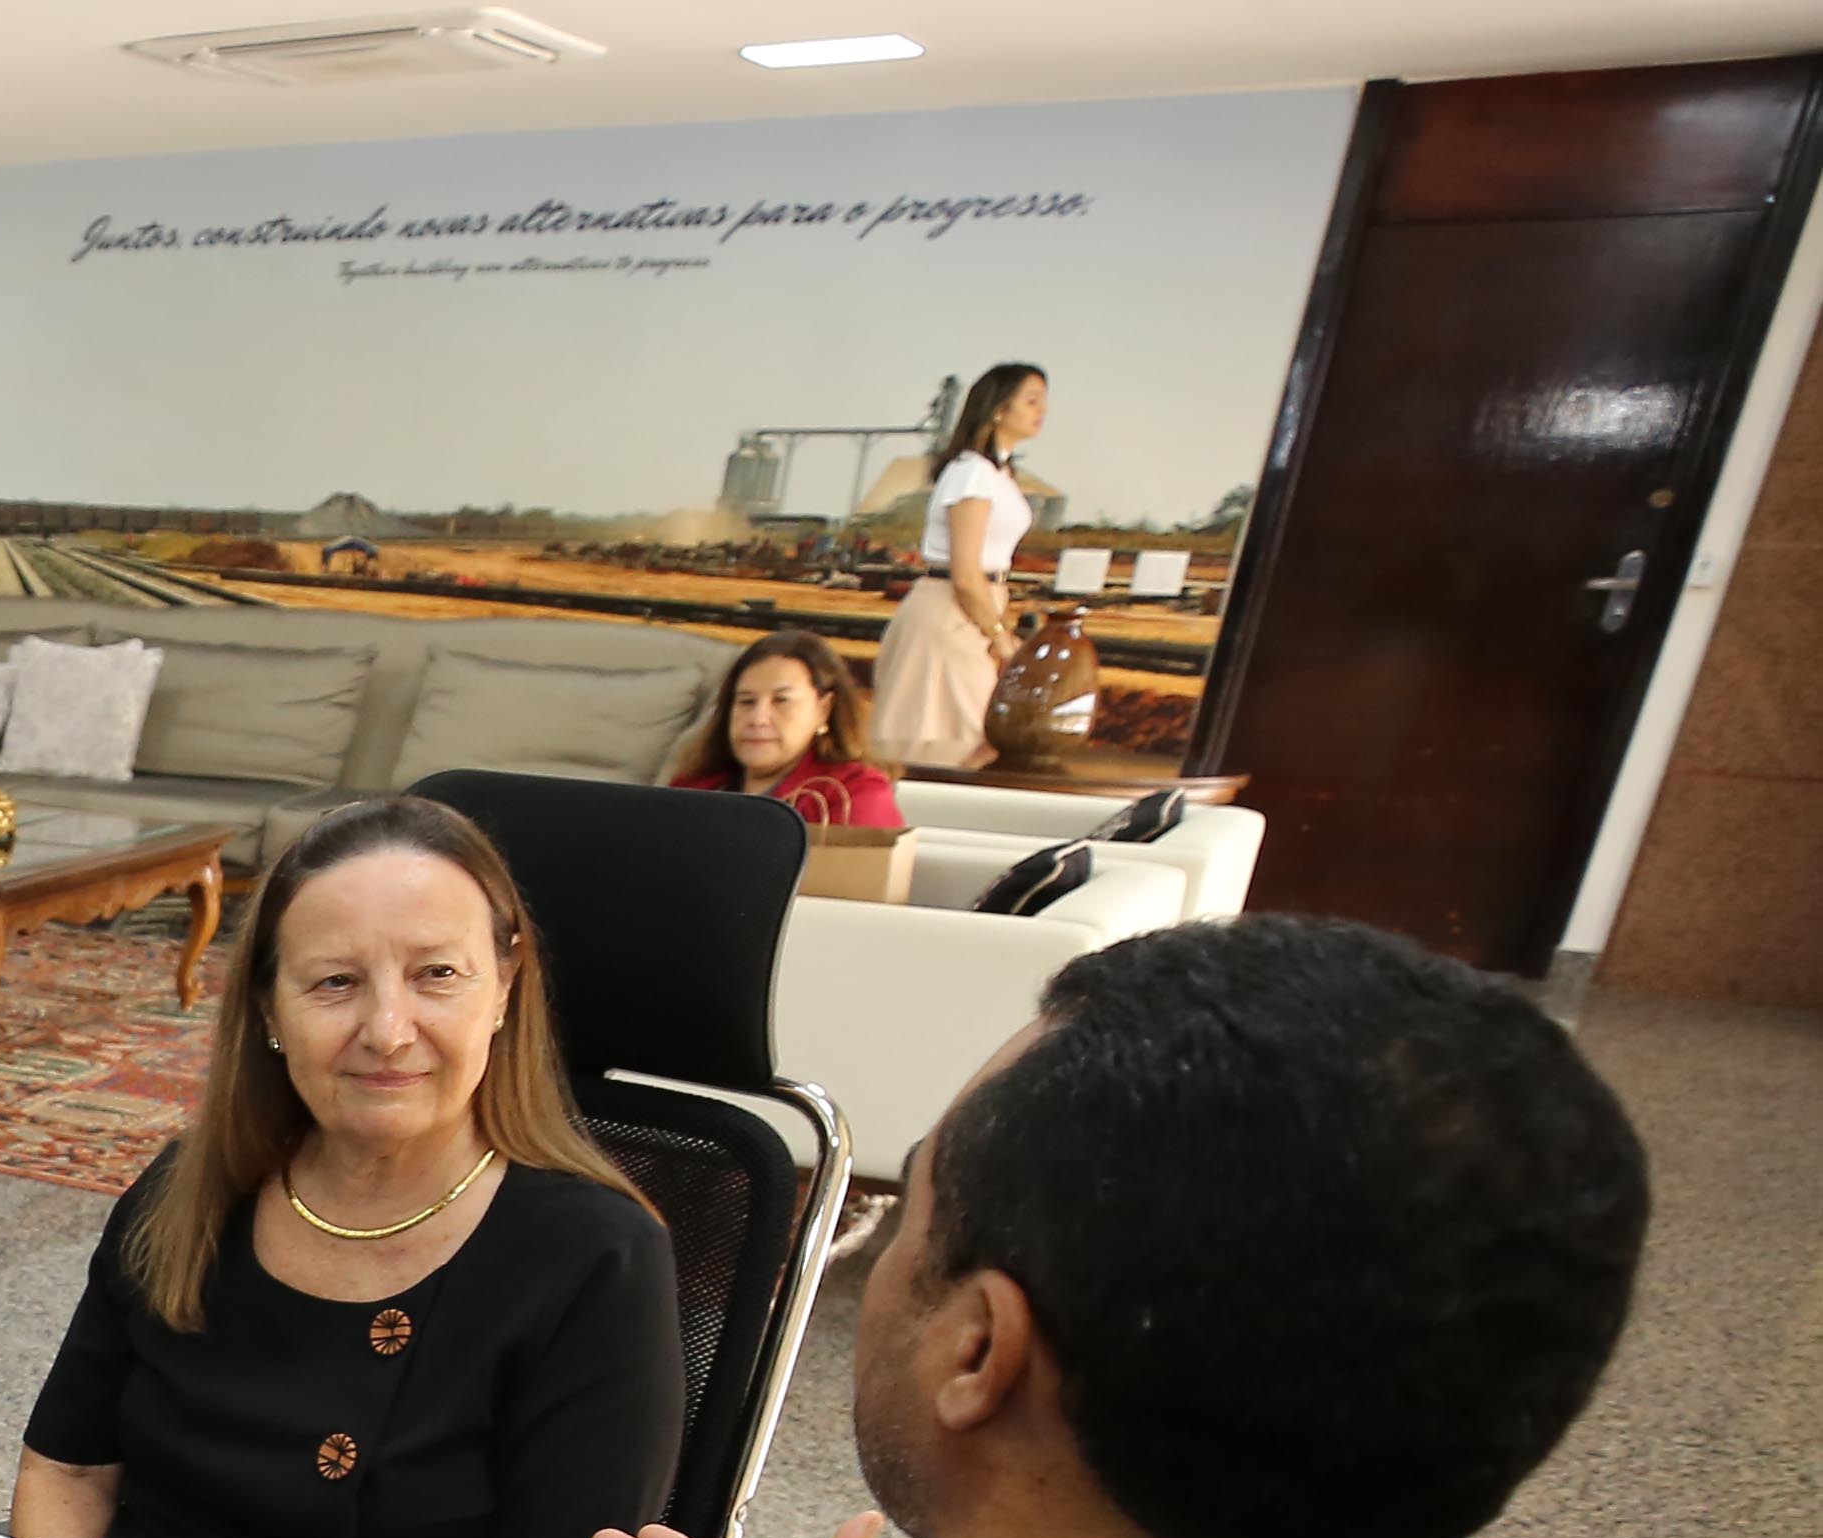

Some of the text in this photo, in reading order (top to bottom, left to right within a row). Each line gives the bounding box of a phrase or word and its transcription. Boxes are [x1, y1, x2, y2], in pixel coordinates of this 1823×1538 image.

[70, 213, 182, 263] Juntos,
[191, 203, 390, 248] construindo
[395, 211, 492, 241] novas
[495, 197, 731, 236] alternativas
[717, 198, 837, 245] para
[841, 200, 869, 224] o
